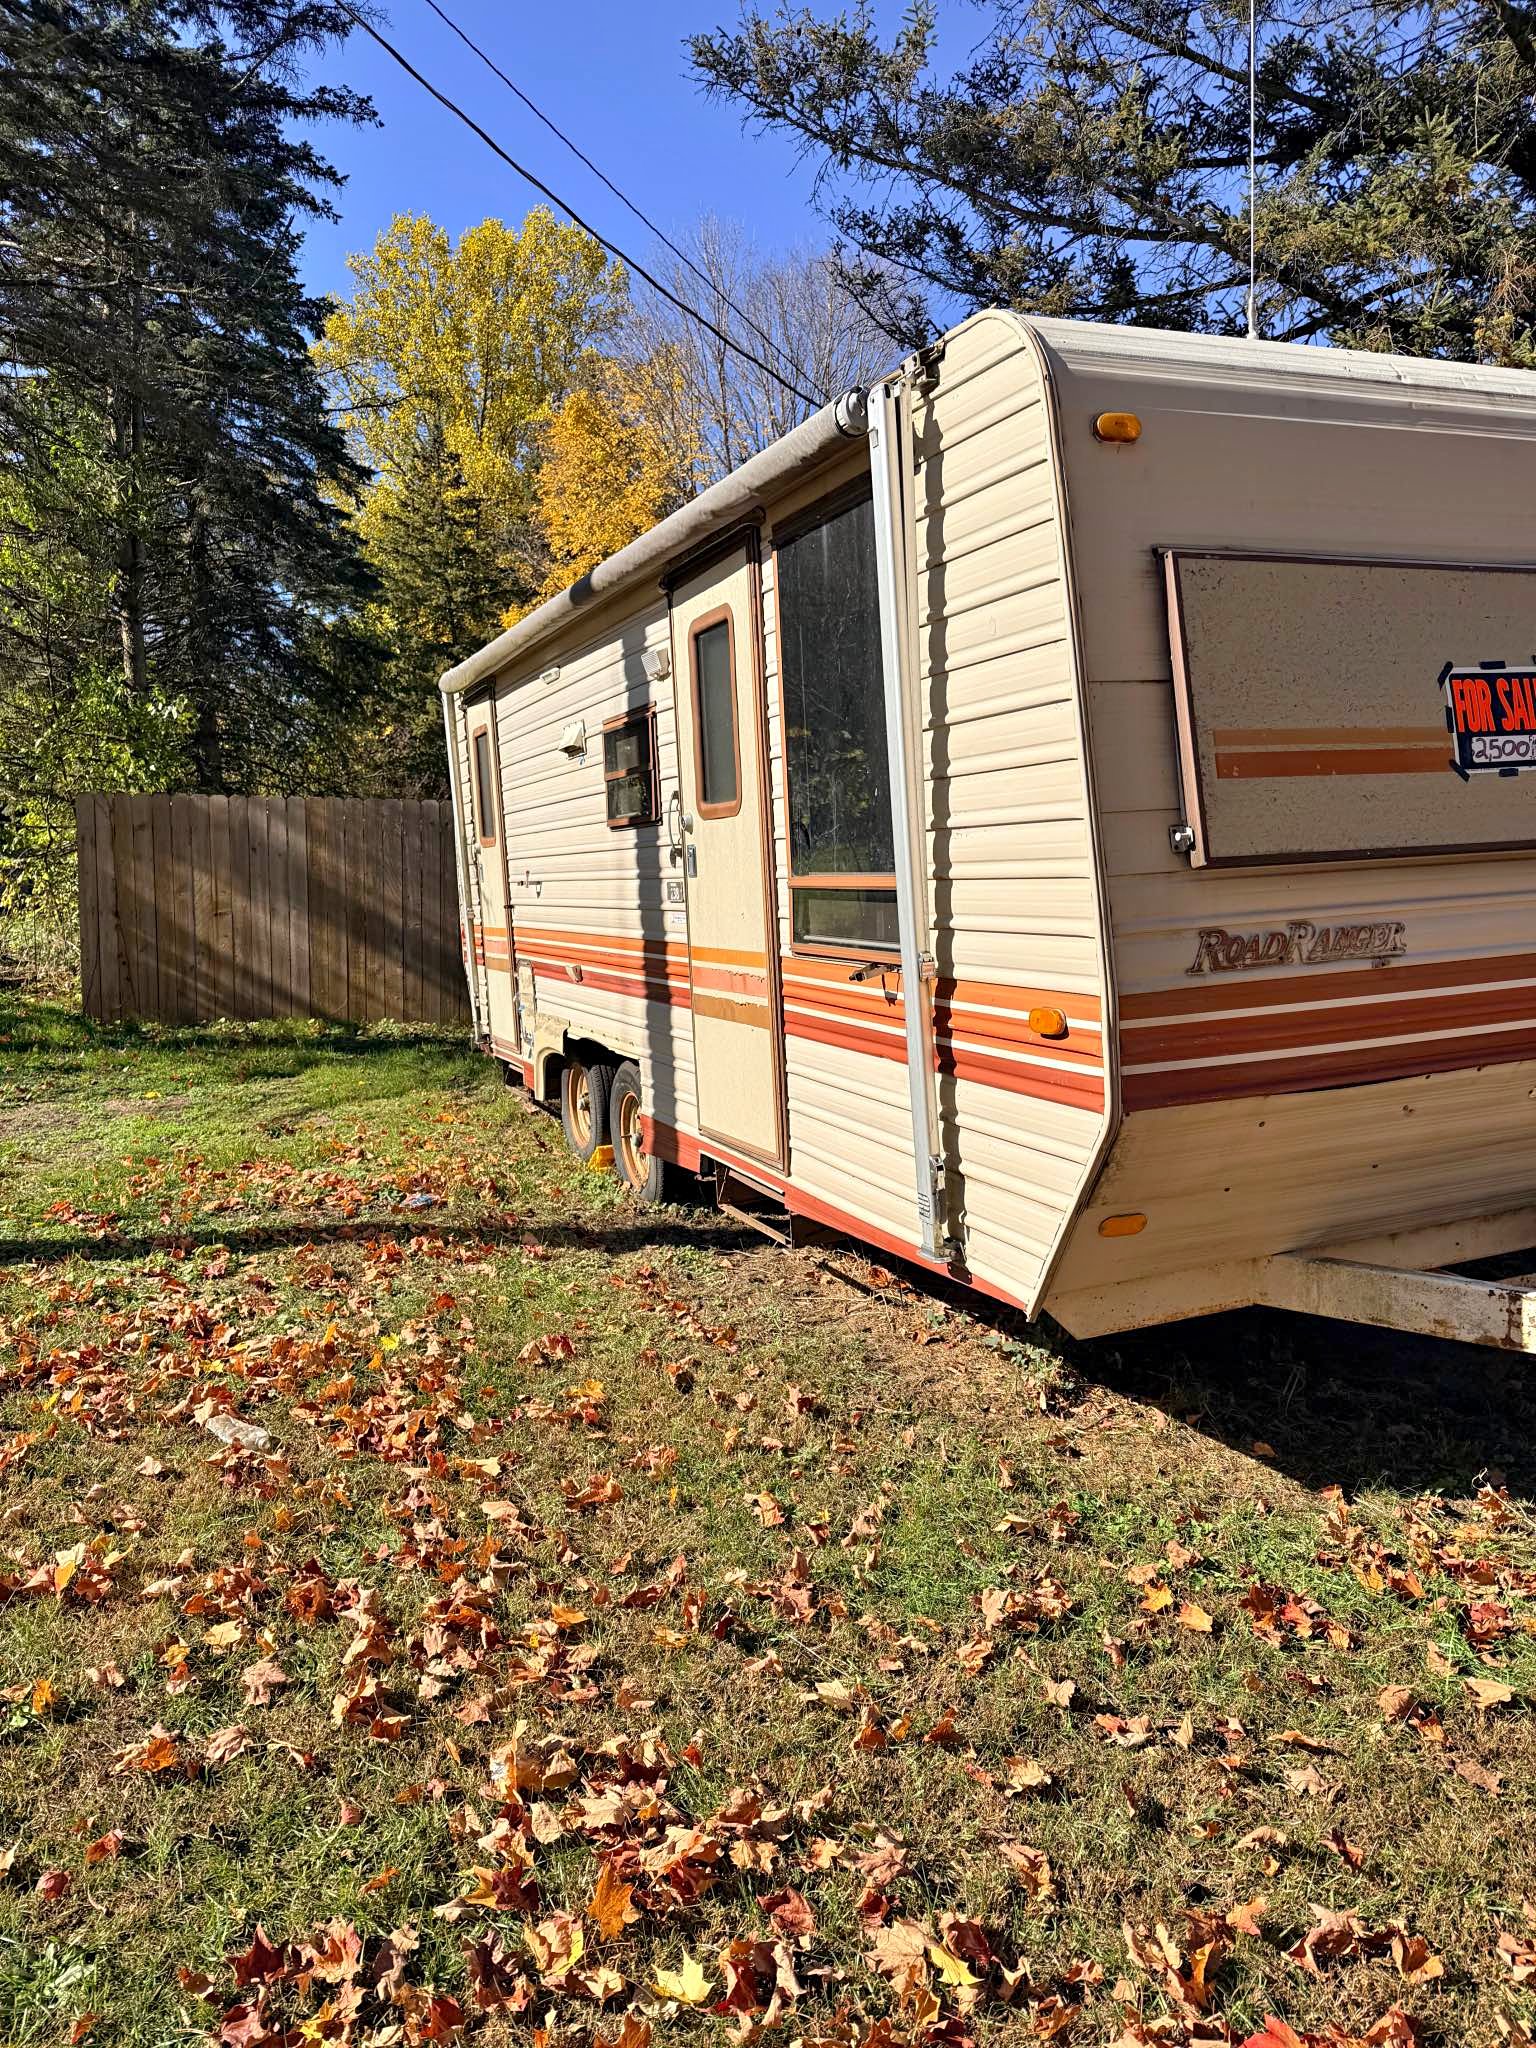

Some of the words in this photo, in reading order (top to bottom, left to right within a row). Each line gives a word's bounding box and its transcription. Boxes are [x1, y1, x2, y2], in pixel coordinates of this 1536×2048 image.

[1452, 679, 1496, 733] FOR
[1496, 678, 1536, 731] SAL
[1472, 738, 1530, 762] 2,500
